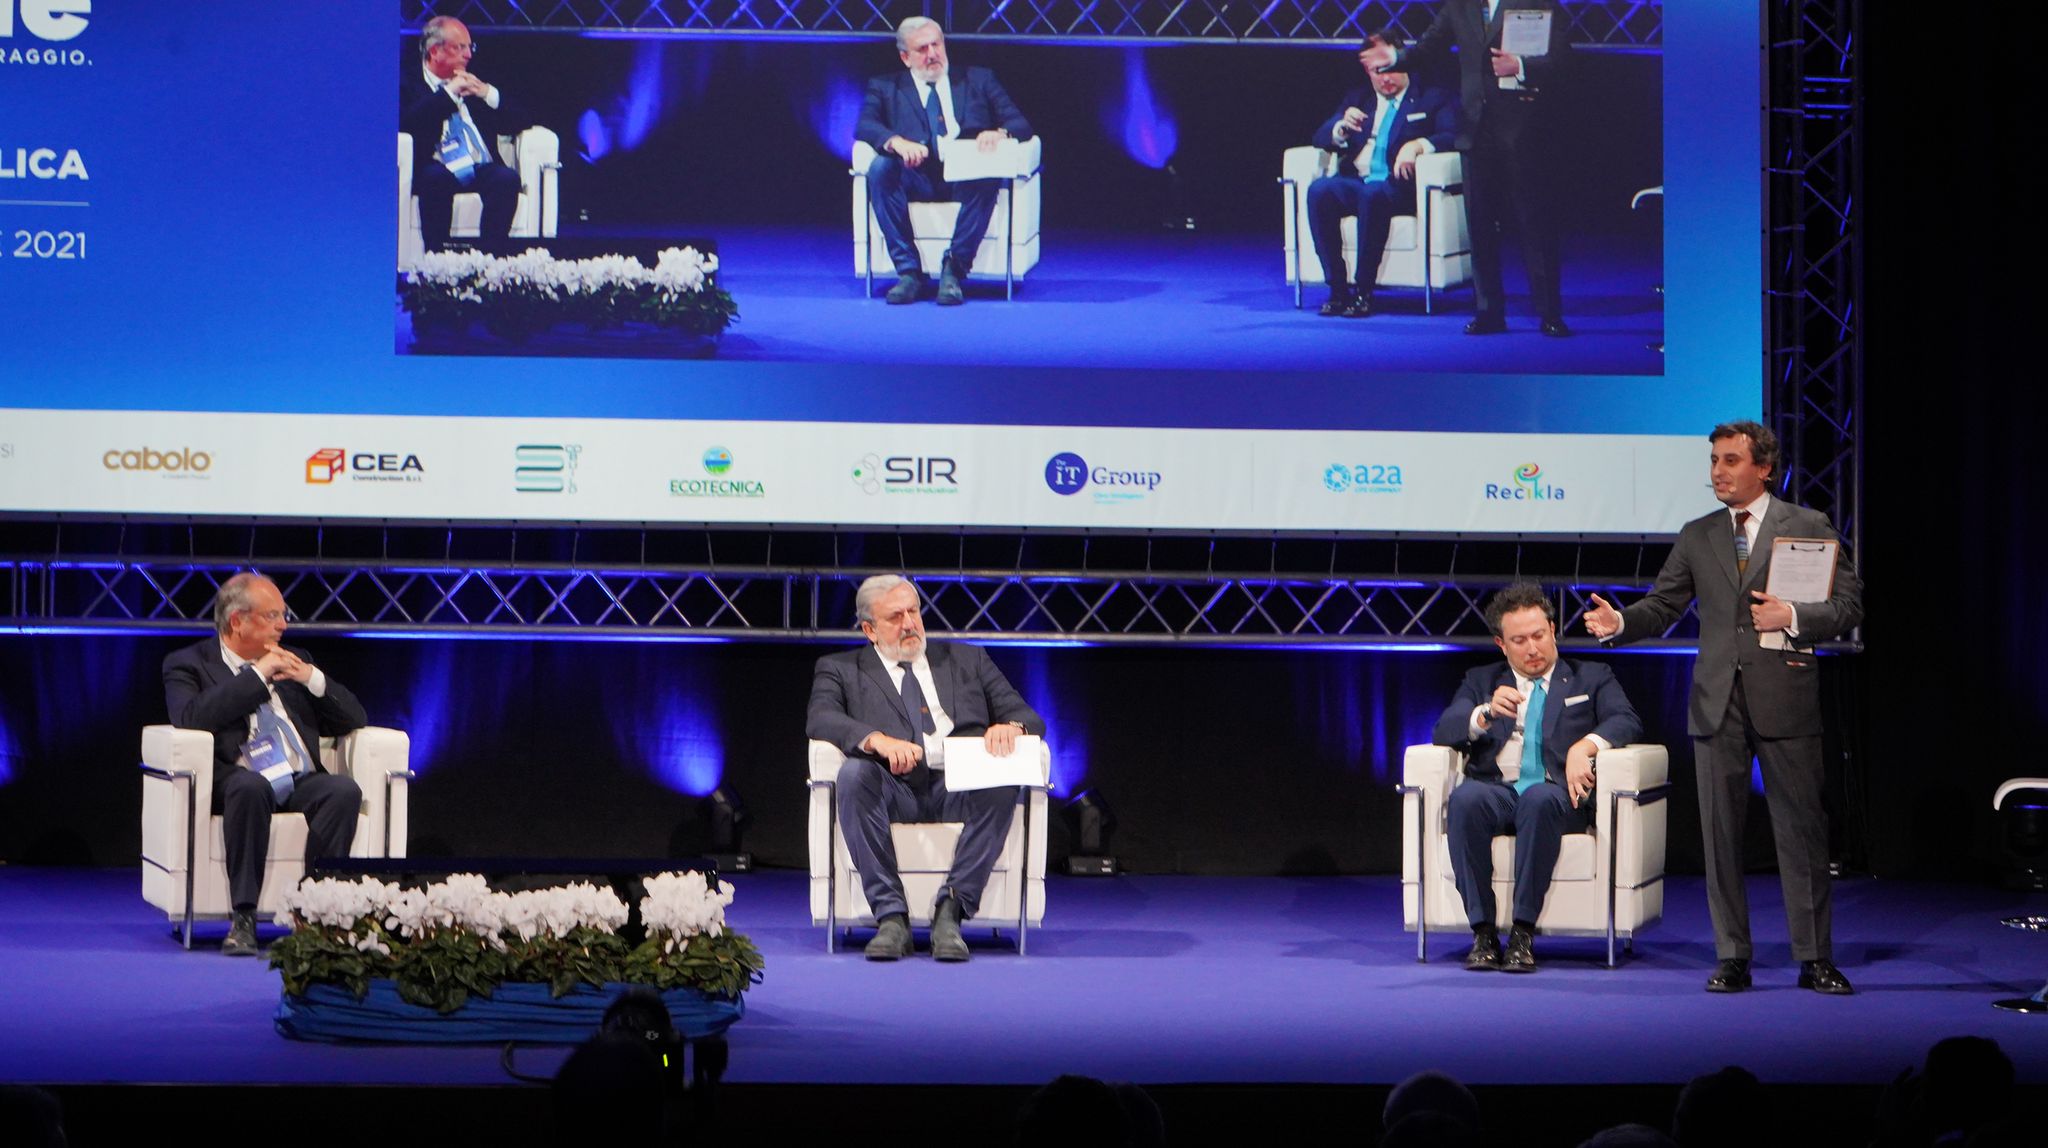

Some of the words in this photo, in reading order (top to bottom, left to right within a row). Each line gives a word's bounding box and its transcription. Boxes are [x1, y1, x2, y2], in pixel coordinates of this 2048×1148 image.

[0, 147, 89, 180] LICA
[13, 229, 86, 259] 2021
[102, 446, 211, 471] cabolo
[352, 453, 424, 472] CEA
[885, 457, 958, 484] SIR
[670, 479, 765, 494] ECOTECNICA
[1091, 466, 1162, 491] Group
[1354, 464, 1403, 485] a2a
[1486, 481, 1565, 500] Recikla
